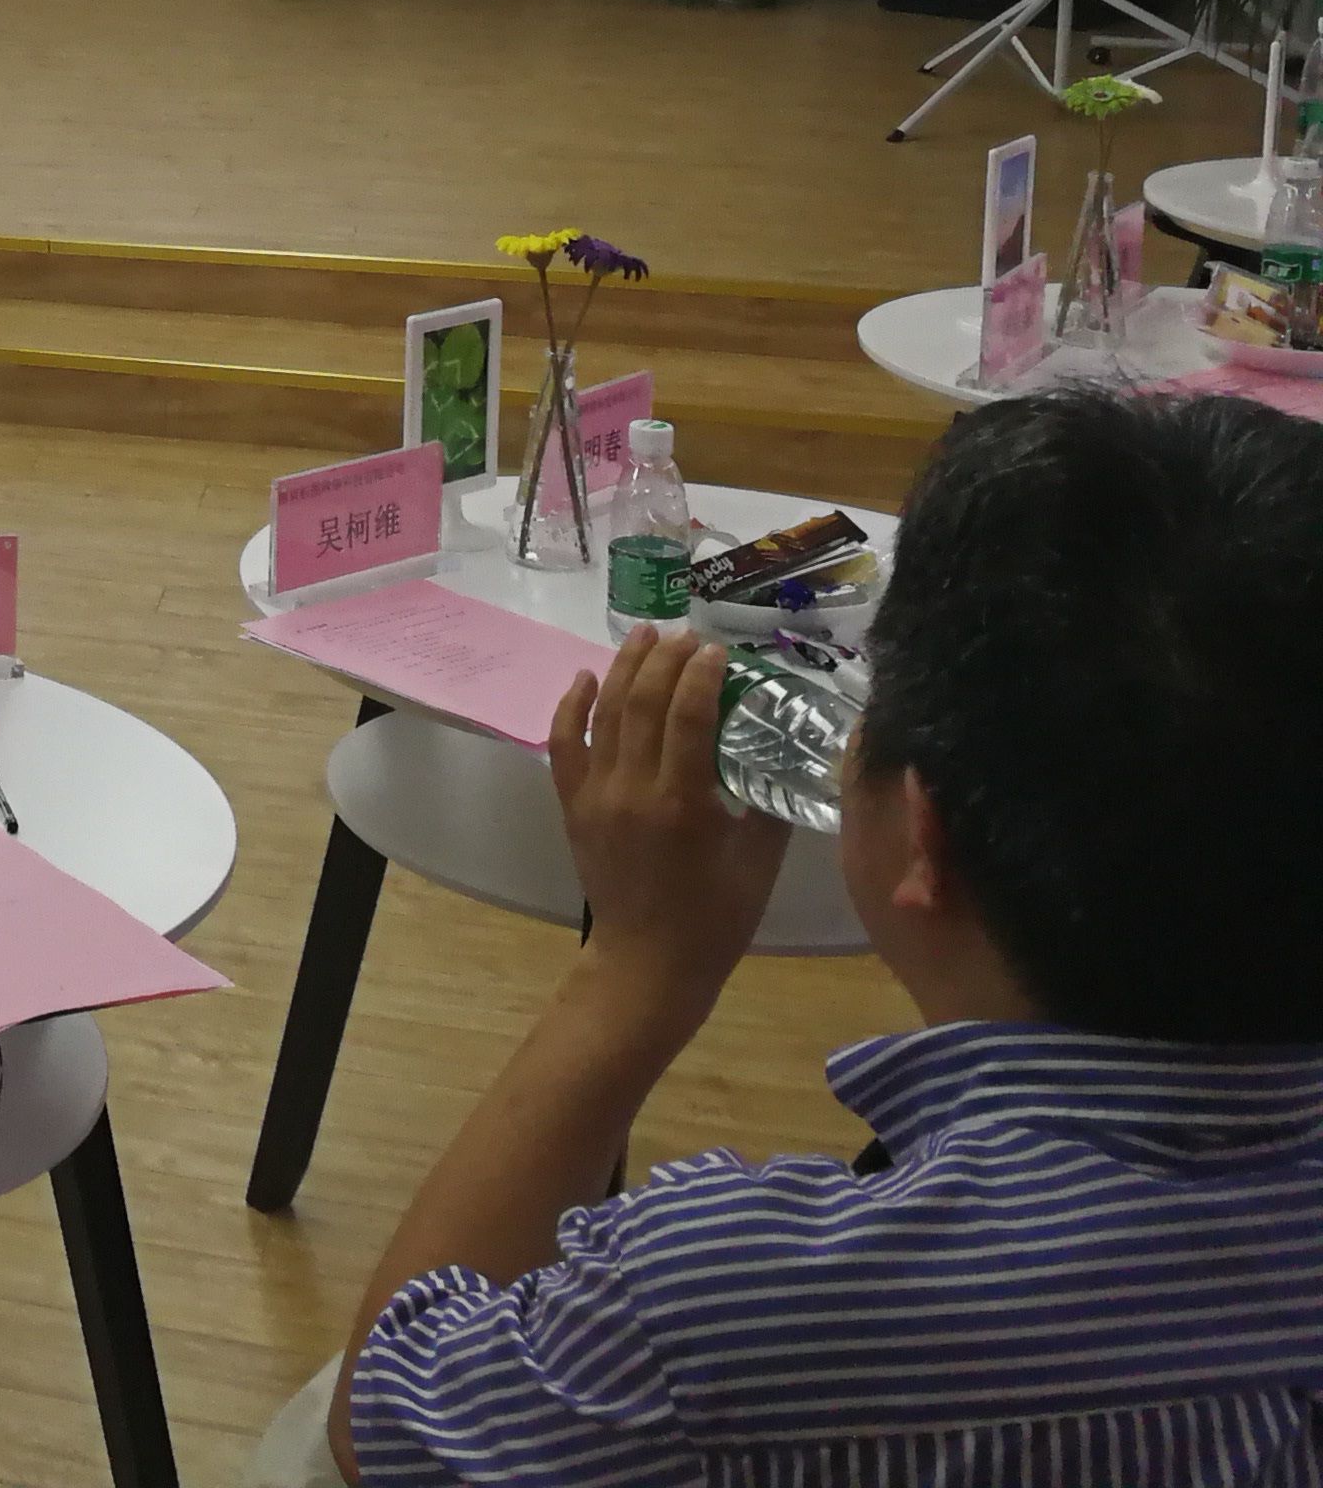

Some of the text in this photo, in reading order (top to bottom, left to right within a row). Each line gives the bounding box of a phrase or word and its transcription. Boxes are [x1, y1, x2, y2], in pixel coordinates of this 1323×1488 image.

[584, 429, 622, 467] 明春
[316, 501, 402, 558] 吴柯维
